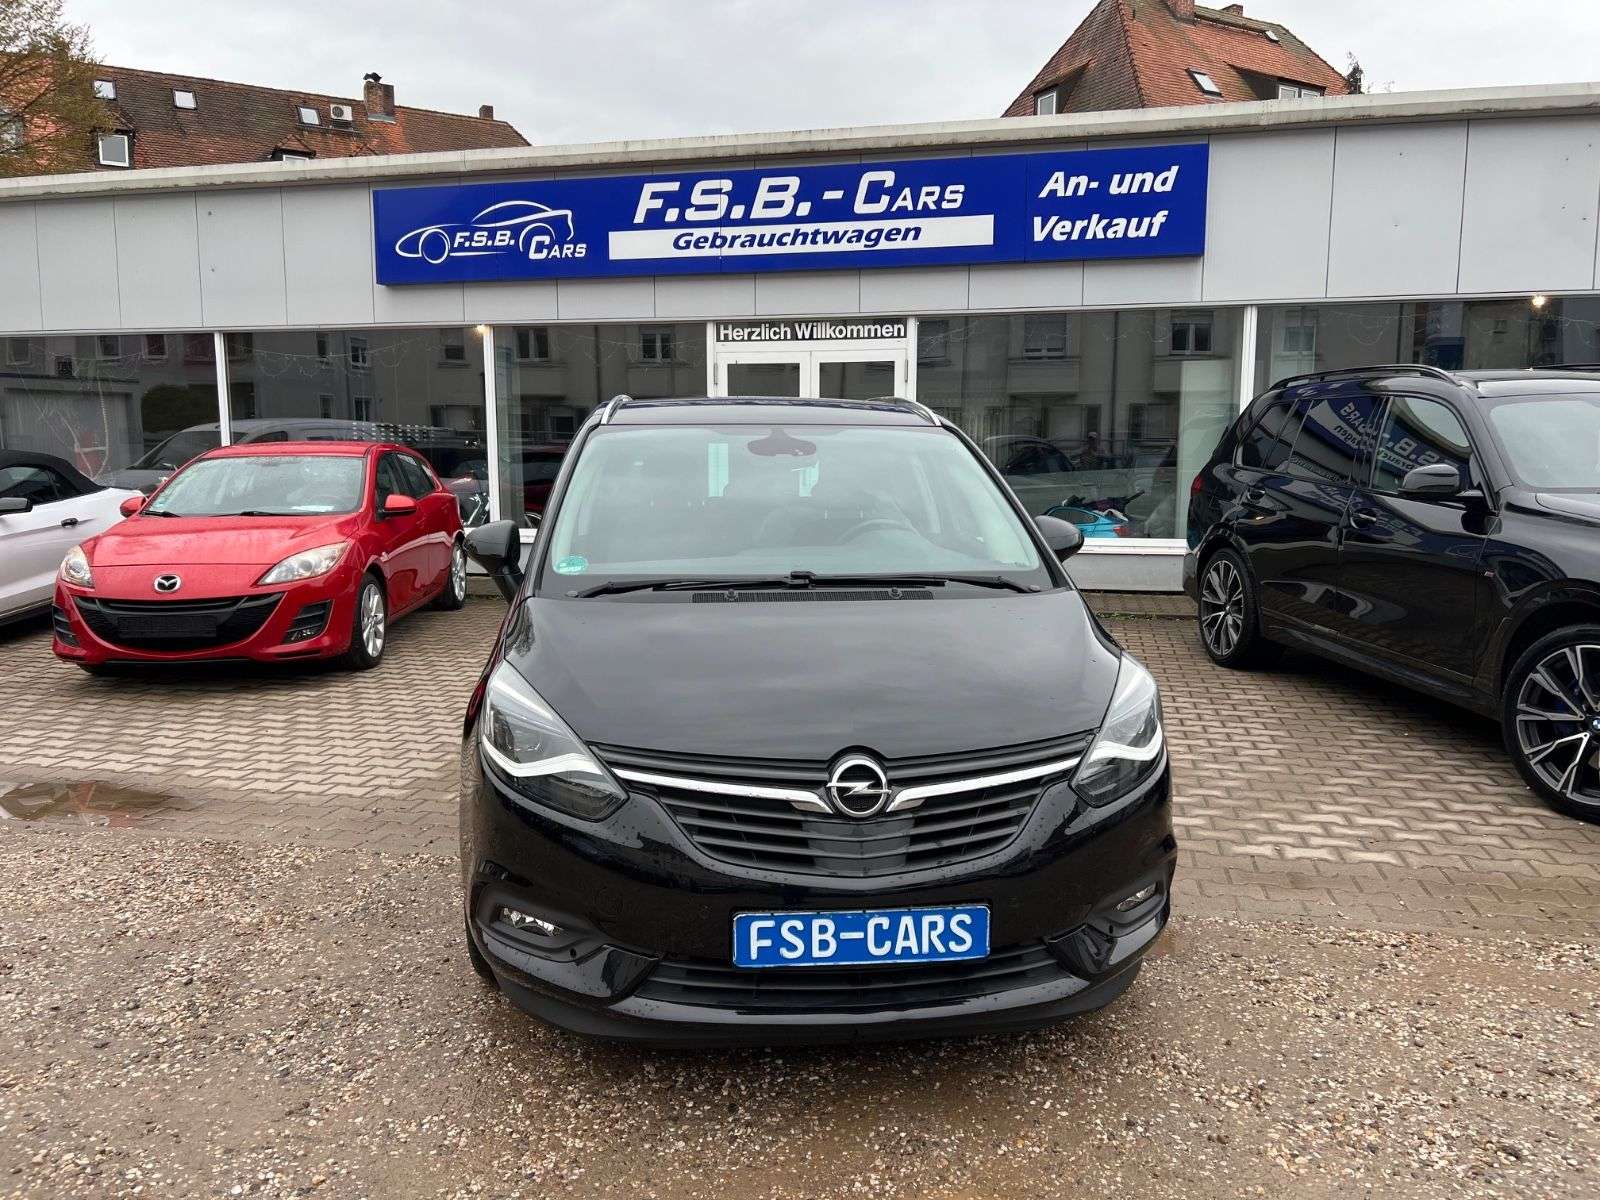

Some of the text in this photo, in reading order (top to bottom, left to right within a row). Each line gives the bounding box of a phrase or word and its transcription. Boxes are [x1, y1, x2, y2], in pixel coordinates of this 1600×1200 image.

[1038, 165, 1180, 198] An- und
[453, 229, 516, 249] F.S.B.
[672, 224, 922, 251] Gebrauchtwagen
[1033, 210, 1169, 242] Verkauf
[719, 323, 905, 341] Herzlich Willkommen
[749, 913, 974, 960] FSB-CARS
